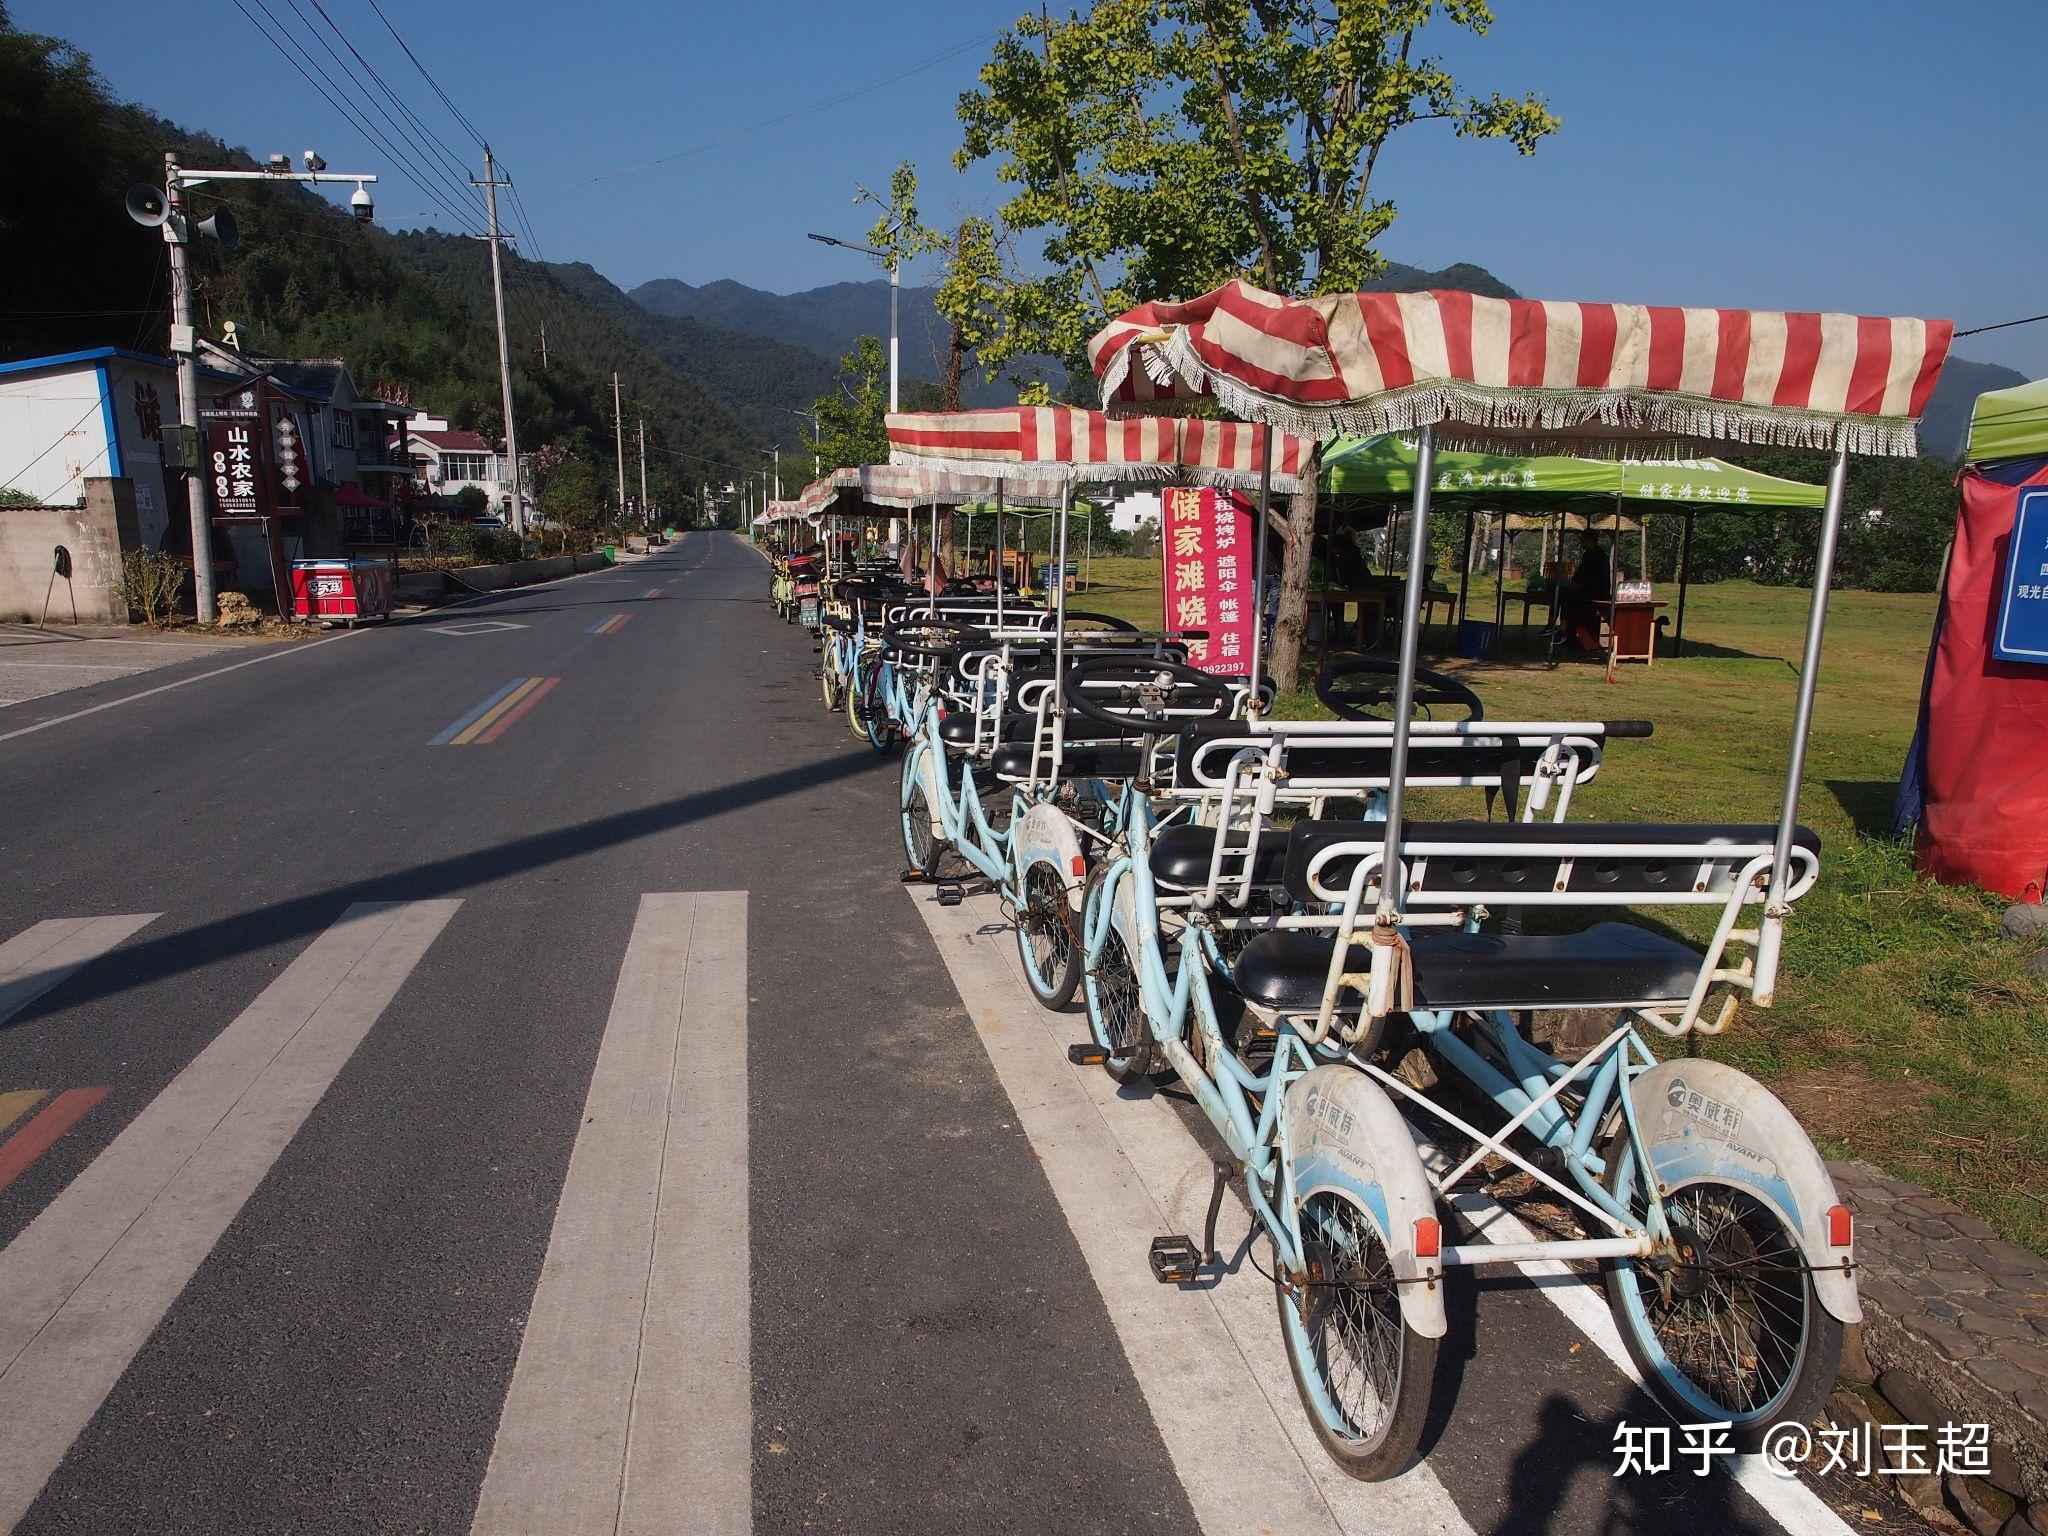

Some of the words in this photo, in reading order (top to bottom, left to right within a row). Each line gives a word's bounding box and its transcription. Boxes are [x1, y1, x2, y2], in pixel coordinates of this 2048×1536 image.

[228, 426, 255, 497] 山水农家
[1639, 483, 1750, 502] 储家滩欢迎您
[1217, 555, 1239, 593] 遮阳伞
[1219, 599, 1240, 623] 帐篷
[1220, 632, 1241, 657] 住宿
[1687, 1091, 1740, 1130] 奥威特
[1337, 1148, 1367, 1169] AVANT
[1726, 1142, 1765, 1163] AVANT
